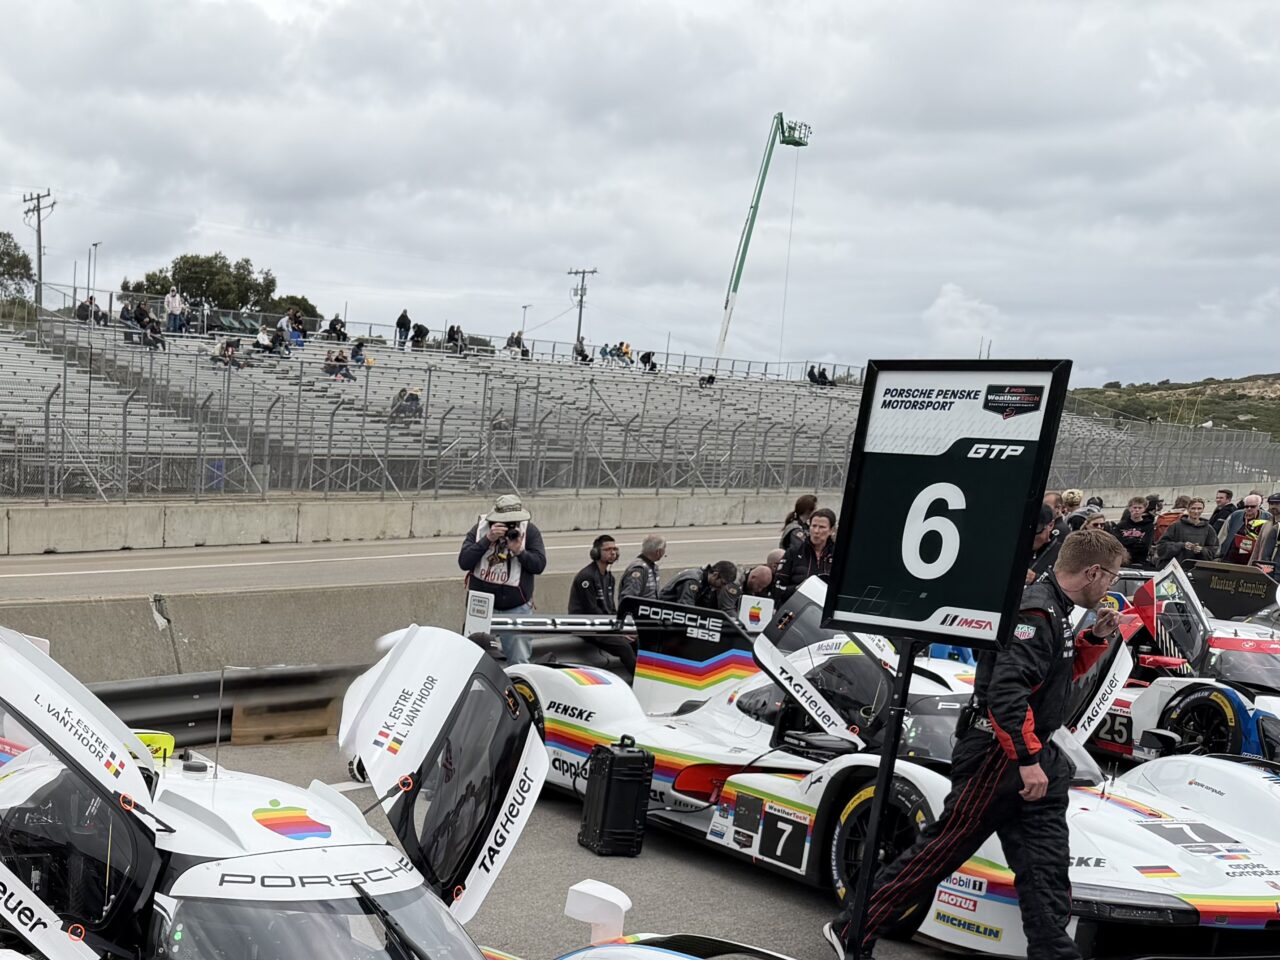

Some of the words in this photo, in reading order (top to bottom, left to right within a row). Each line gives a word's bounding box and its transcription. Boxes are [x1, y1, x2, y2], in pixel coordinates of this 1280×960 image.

[881, 399, 955, 411] MOTORSPORT
[883, 388, 934, 399] PORSCHE
[935, 389, 981, 400] PENSKE
[967, 443, 1025, 460] GTP
[901, 482, 967, 580] 6
[1210, 575, 1237, 595] Mustang
[1238, 579, 1268, 599] Sampling
[638, 605, 723, 631] PORSCHE
[956, 617, 993, 631] IMSA
[686, 627, 722, 643] 963
[388, 688, 414, 721] ESTRE
[401, 675, 438, 728] VANTHOOR
[546, 700, 597, 722] PENSKE
[47, 703, 105, 762] VANTHOOR
[76, 720, 109, 753] ESTRE
[1098, 715, 1128, 744] 25
[551, 757, 589, 779] apple
[768, 804, 809, 823] WeatherTech
[776, 821, 795, 857] 7
[1161, 823, 1206, 843] 7
[218, 856, 415, 888] PORSCHE
[939, 891, 976, 911] MOTUL
[936, 911, 1000, 939] MICHELIN
